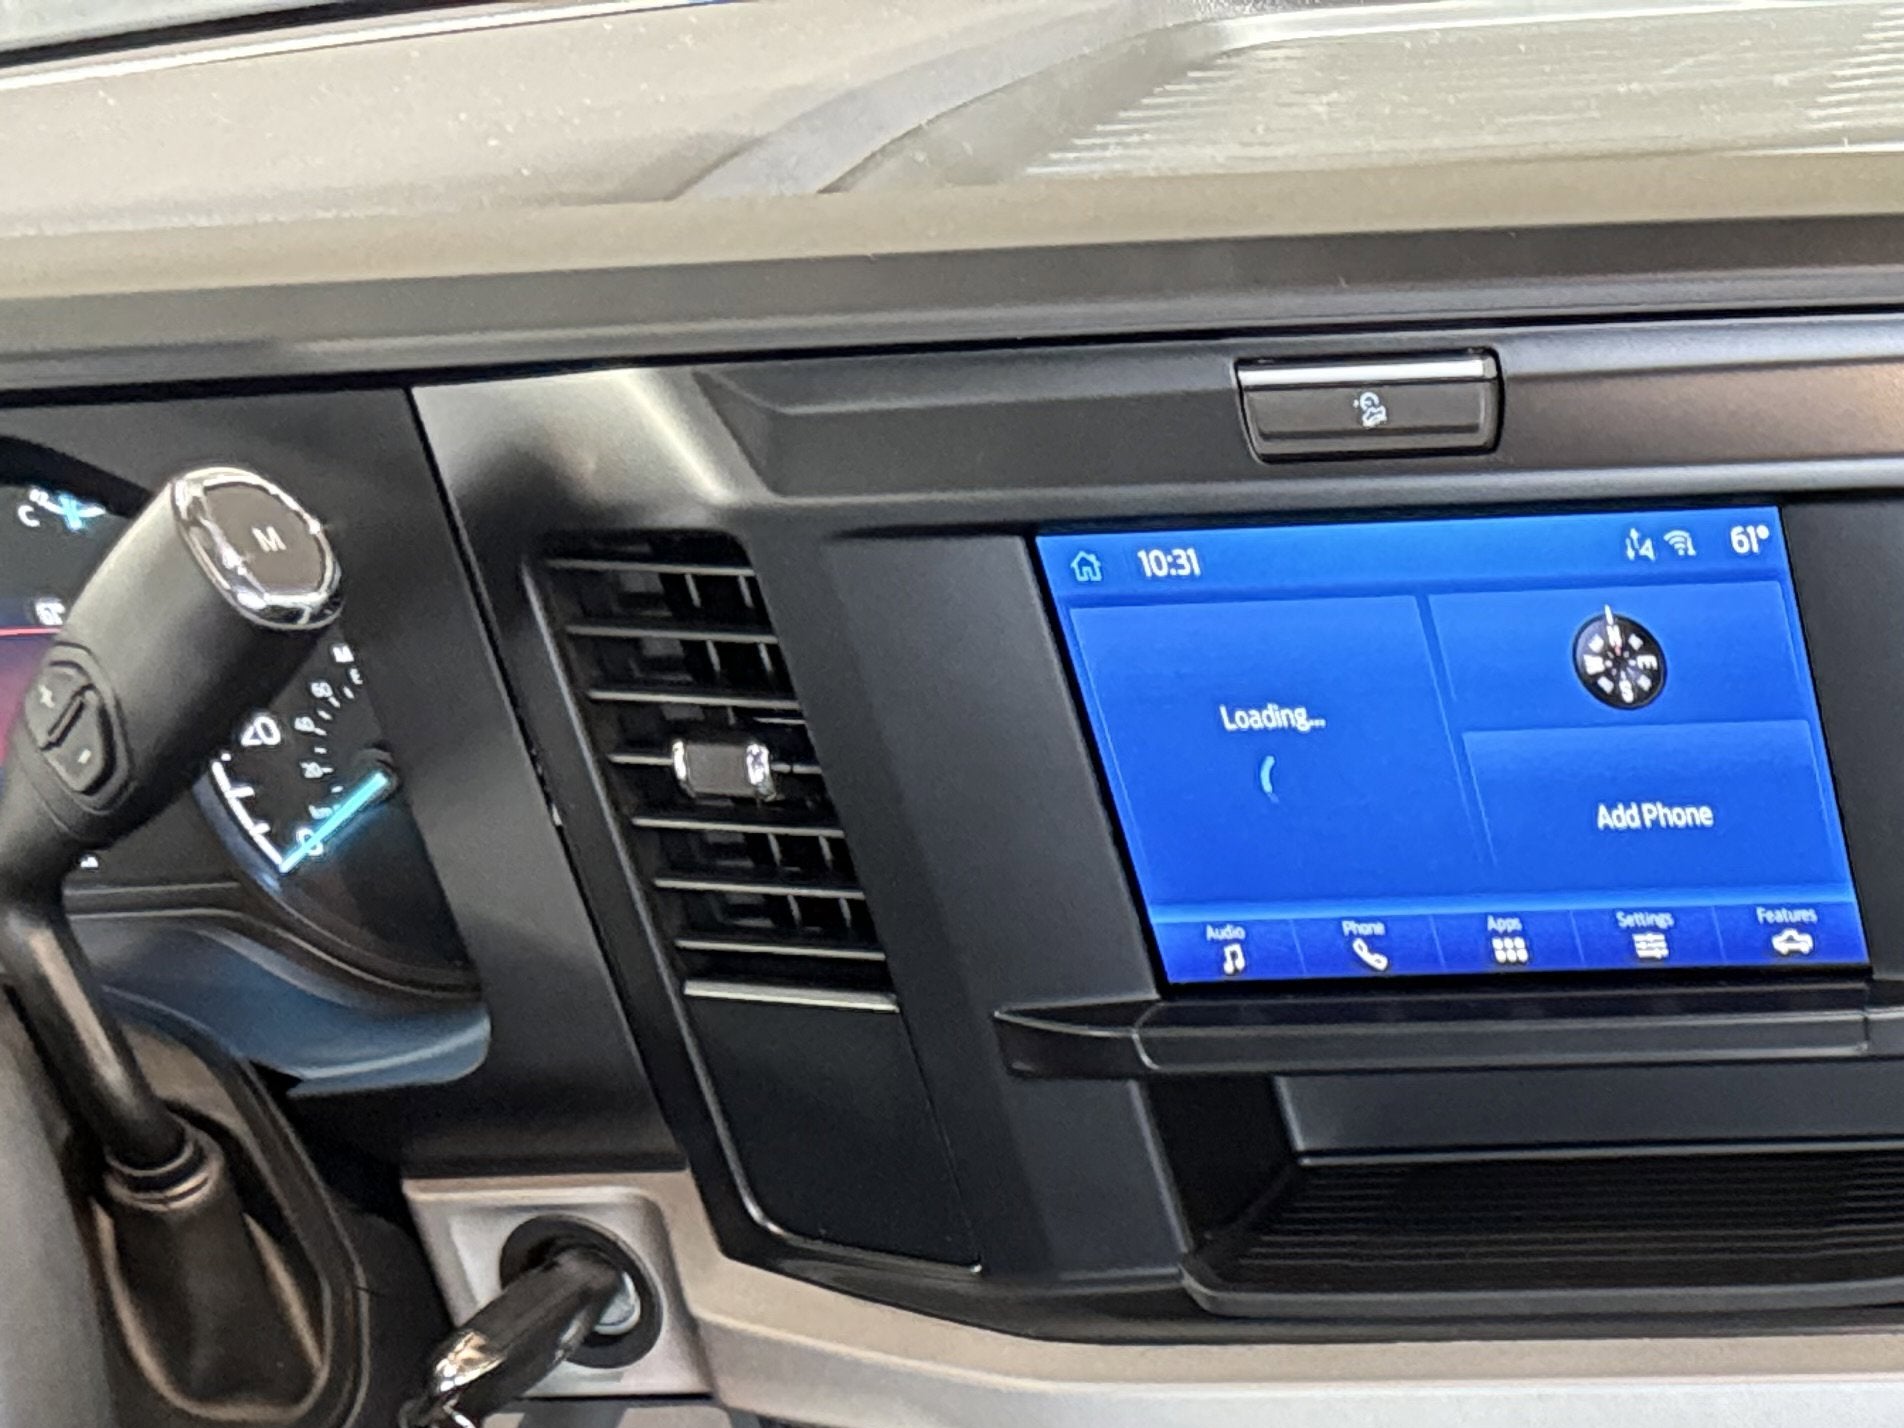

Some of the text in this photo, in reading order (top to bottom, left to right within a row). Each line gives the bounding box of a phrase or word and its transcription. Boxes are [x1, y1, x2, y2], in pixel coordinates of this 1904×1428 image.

[252, 526, 287, 552] M
[1730, 524, 1770, 554] 61°
[1137, 548, 1201, 578] 10:31
[1219, 702, 1326, 732] Loading...
[1598, 800, 1714, 830] Add Phone
[1487, 915, 1523, 933] Apps
[1616, 911, 1675, 929] Settings
[1756, 906, 1818, 924] Features
[1206, 924, 1246, 941] Audio
[1342, 920, 1385, 937] Phone
